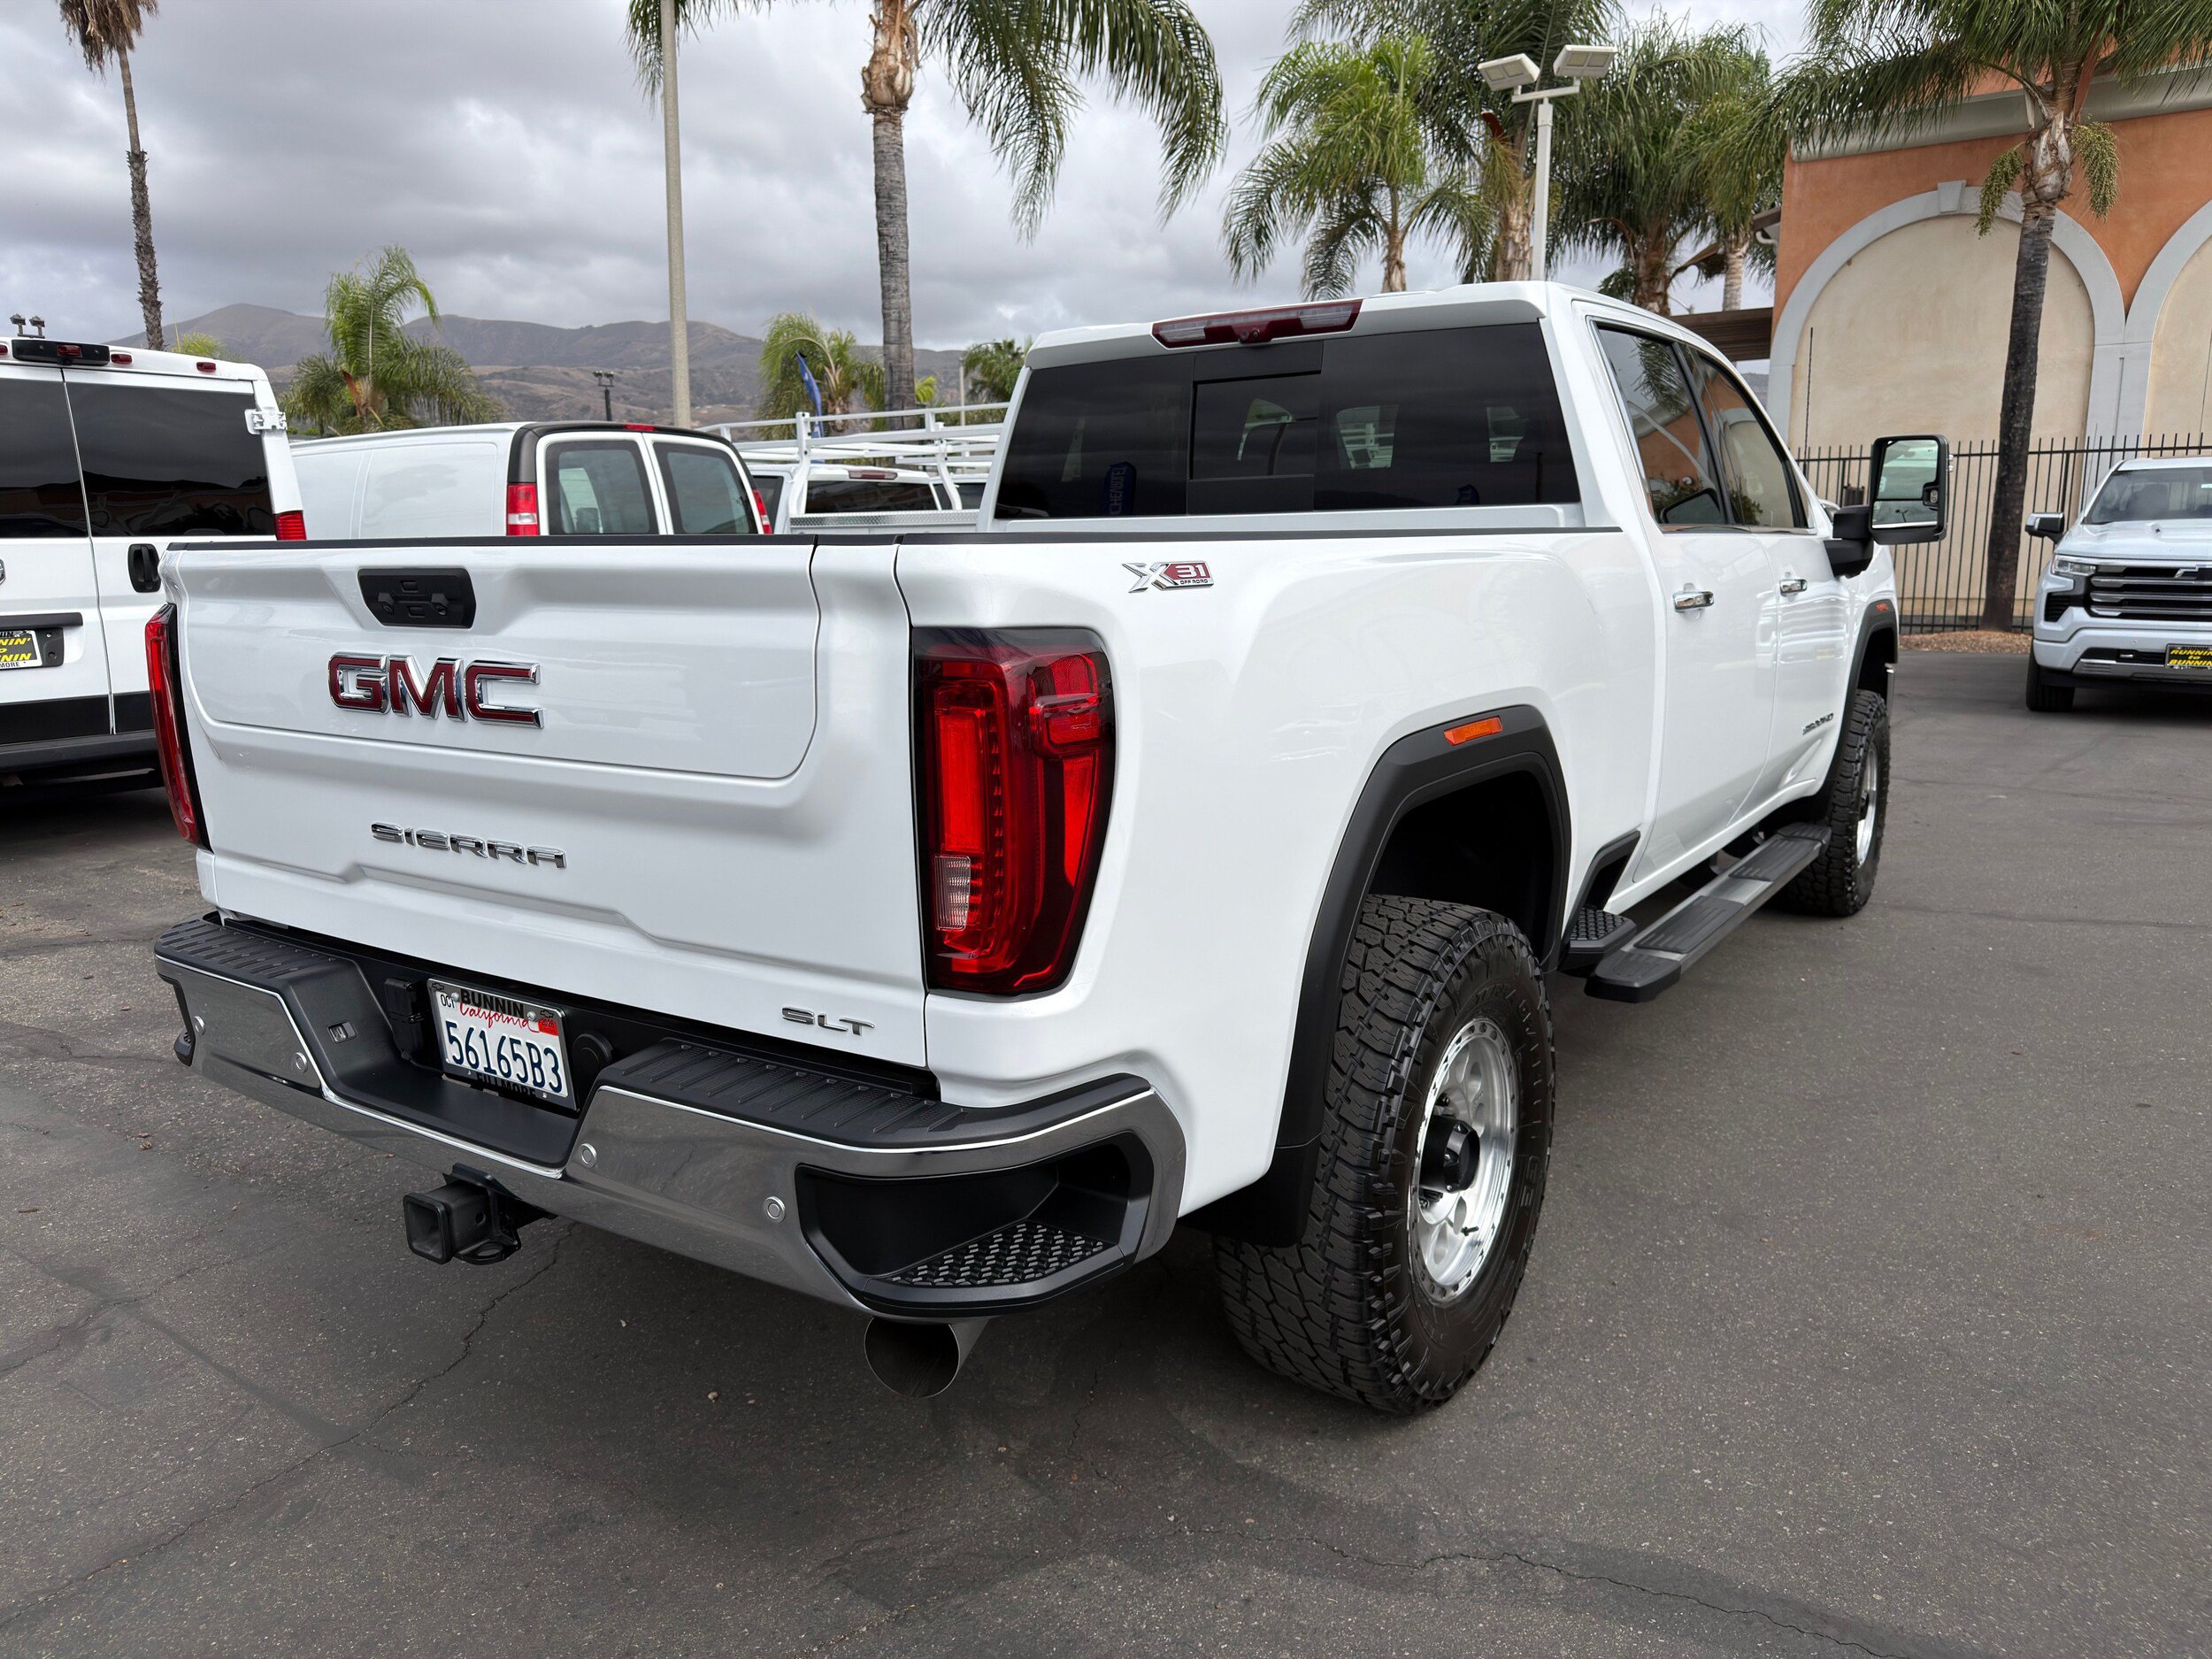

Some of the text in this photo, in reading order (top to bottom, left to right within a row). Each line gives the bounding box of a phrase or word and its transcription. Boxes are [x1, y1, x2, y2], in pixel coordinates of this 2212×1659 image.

[328, 651, 545, 729] GMC
[371, 822, 567, 870] SIERRA
[459, 1002, 541, 1034] California
[460, 987, 525, 1018] BUNNIN
[781, 1006, 876, 1037] SLT
[445, 1019, 563, 1094] 56165B3
